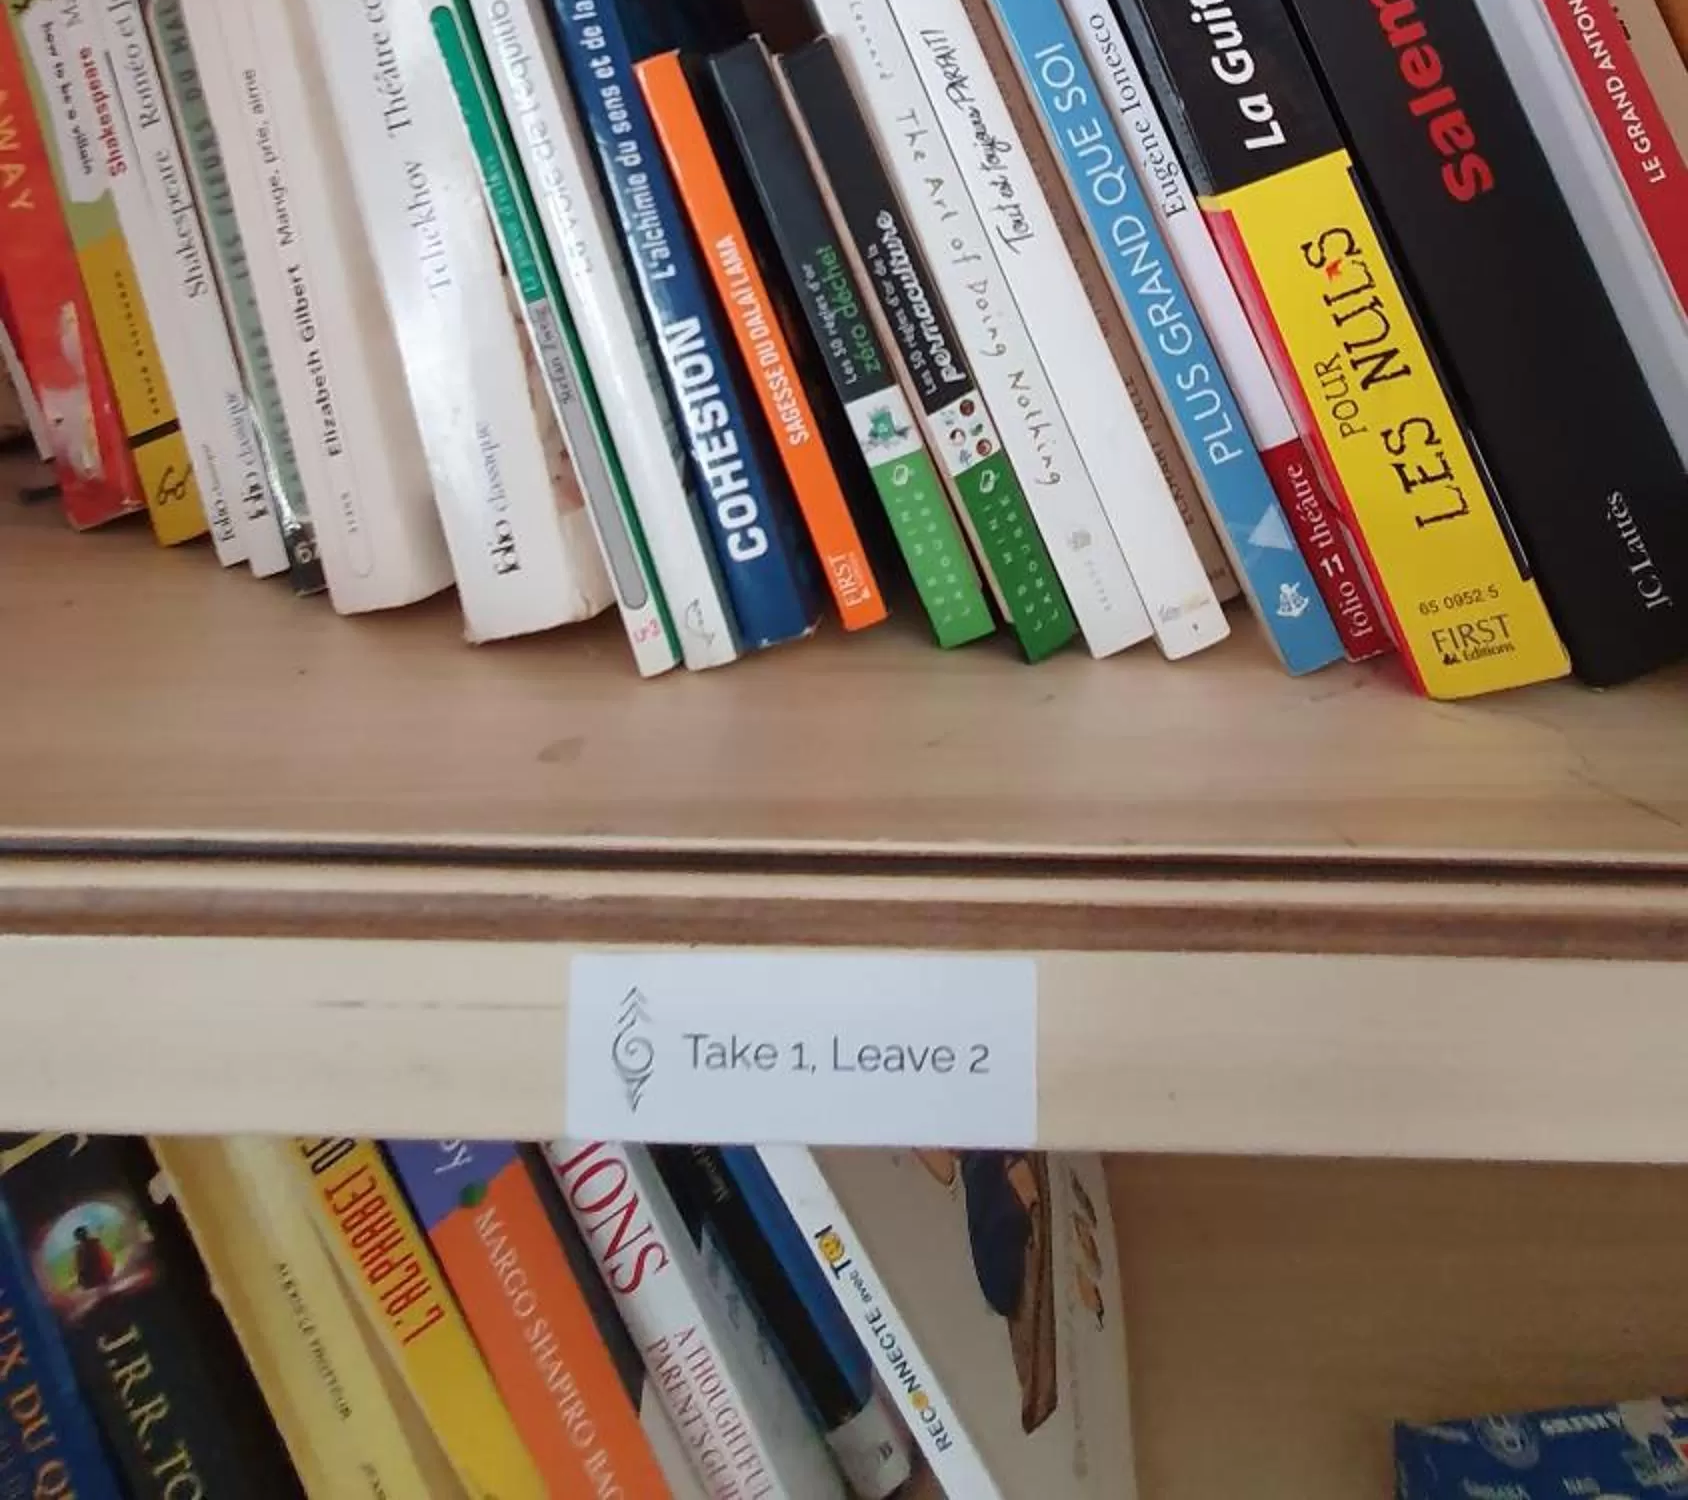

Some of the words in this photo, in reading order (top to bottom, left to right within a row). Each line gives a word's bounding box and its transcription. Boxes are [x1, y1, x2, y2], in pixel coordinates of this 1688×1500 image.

[109, 14, 136, 40] et
[575, 22, 608, 54] de
[587, 52, 617, 82] et
[1078, 11, 1145, 115] Ionesco
[75, 44, 129, 177] Shakespeare
[119, 41, 163, 129] Roméo
[238, 67, 267, 116] aime
[361, 28, 417, 137] Théâtre
[599, 83, 632, 136] sens
[1035, 43, 1087, 112] SOI
[1603, 72, 1654, 156] GRAND
[0, 92, 33, 209] WAY
[523, 120, 556, 163] de
[608, 137, 644, 172] du
[894, 106, 936, 163] The
[1069, 117, 1128, 202] QUE
[1240, 92, 1285, 150] La
[922, 171, 960, 223] Art
[1123, 114, 1195, 220] Eugène
[1642, 155, 1667, 184] LE
[149, 146, 214, 299] Shakespeare
[393, 157, 458, 297] Tchekhov
[621, 169, 677, 283] L'alchimie
[710, 233, 750, 288] LAMA
[944, 232, 980, 268] of
[986, 196, 1038, 258] Tout
[285, 264, 317, 343] Gilbert
[871, 206, 962, 386] permaculture
[954, 276, 1018, 364] Doing
[1113, 215, 1209, 357] GRAND
[1301, 227, 1411, 391] NULS
[752, 339, 779, 367] DU
[841, 321, 884, 377] zéro
[304, 349, 343, 457] Elizabeth
[761, 362, 811, 446] SAGESSE
[992, 366, 1072, 491] Nothing
[1177, 363, 1243, 465] PLUS
[1314, 352, 1367, 438] POUR
[1280, 459, 1336, 552] théâtre
[1380, 416, 1470, 530] LES
[827, 551, 863, 607] FIRST
[1333, 579, 1372, 638] folio
[1431, 614, 1511, 653] FIRST
[682, 1033, 777, 1070] Take
[792, 1042, 817, 1074] 1,
[833, 1035, 955, 1073] Leave
[970, 1045, 990, 1073] 2
[470, 1205, 542, 1320] MARGO
[521, 1316, 600, 1451] SHAPIRO
[10, 1385, 57, 1452] DU
